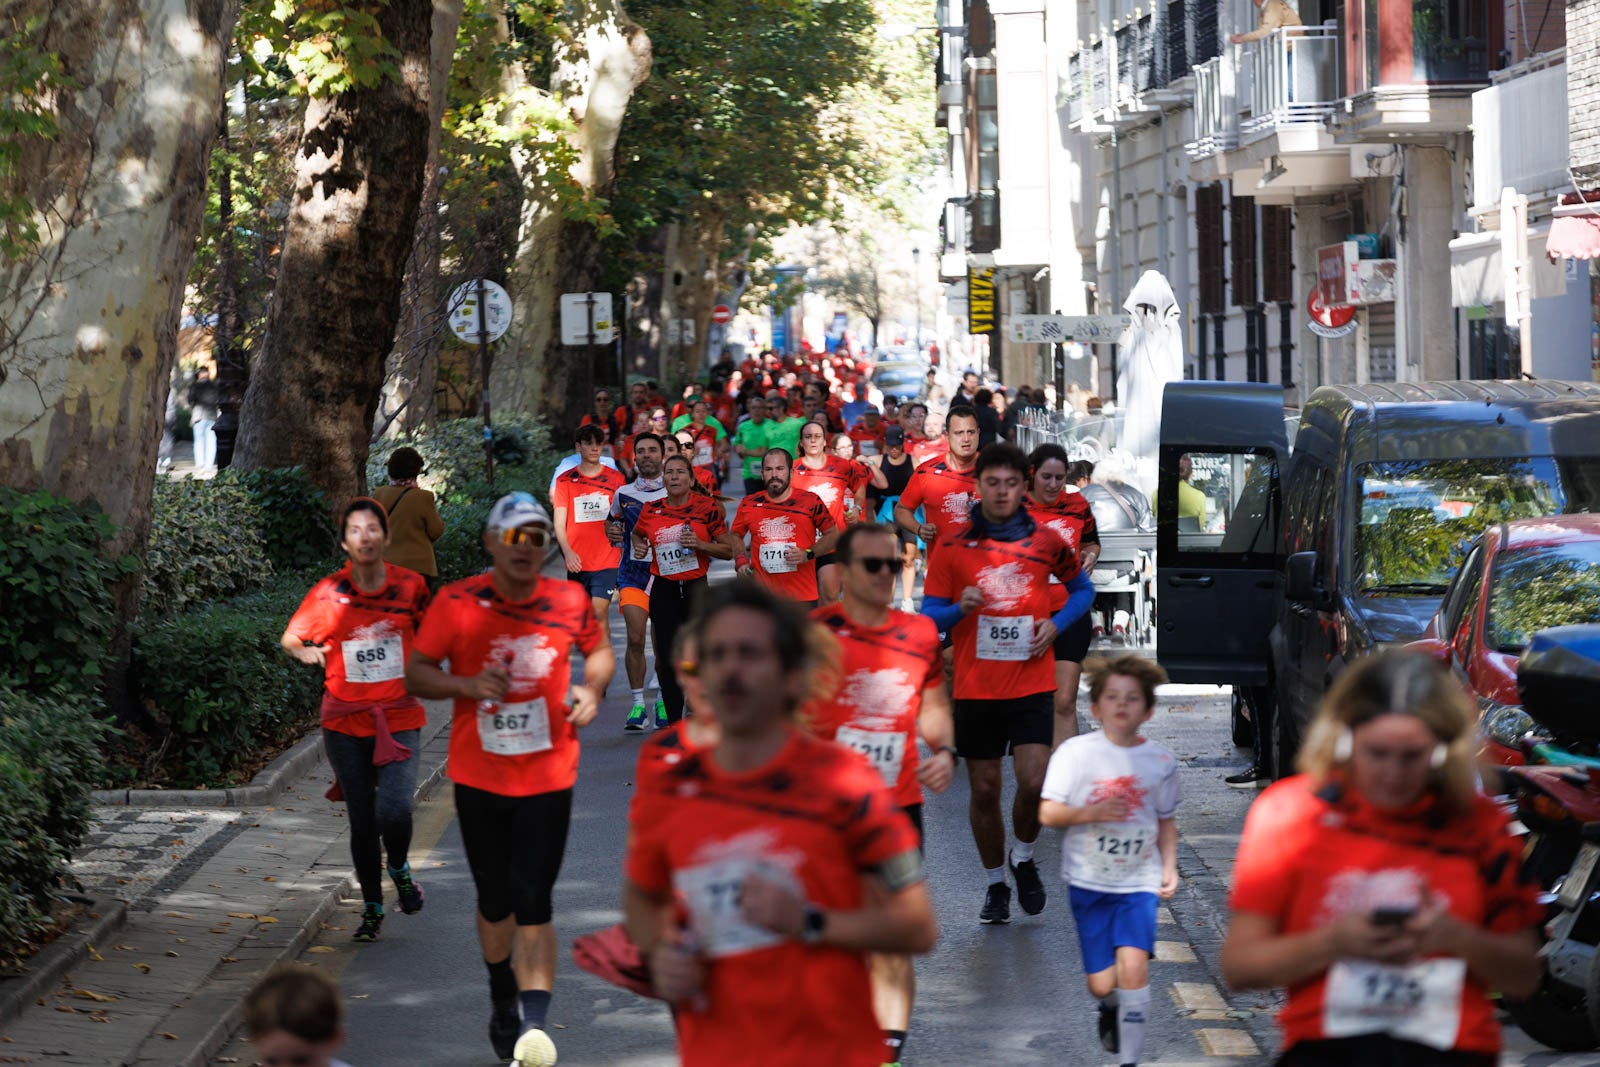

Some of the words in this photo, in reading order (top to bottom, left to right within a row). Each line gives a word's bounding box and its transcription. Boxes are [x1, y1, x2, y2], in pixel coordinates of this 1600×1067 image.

[582, 501, 600, 510] 734
[656, 533, 681, 542] carre
[661, 548, 687, 561] 110
[990, 626, 1019, 639] 856
[356, 648, 386, 663] 658
[493, 713, 530, 731] 667
[1097, 835, 1144, 855] 1217
